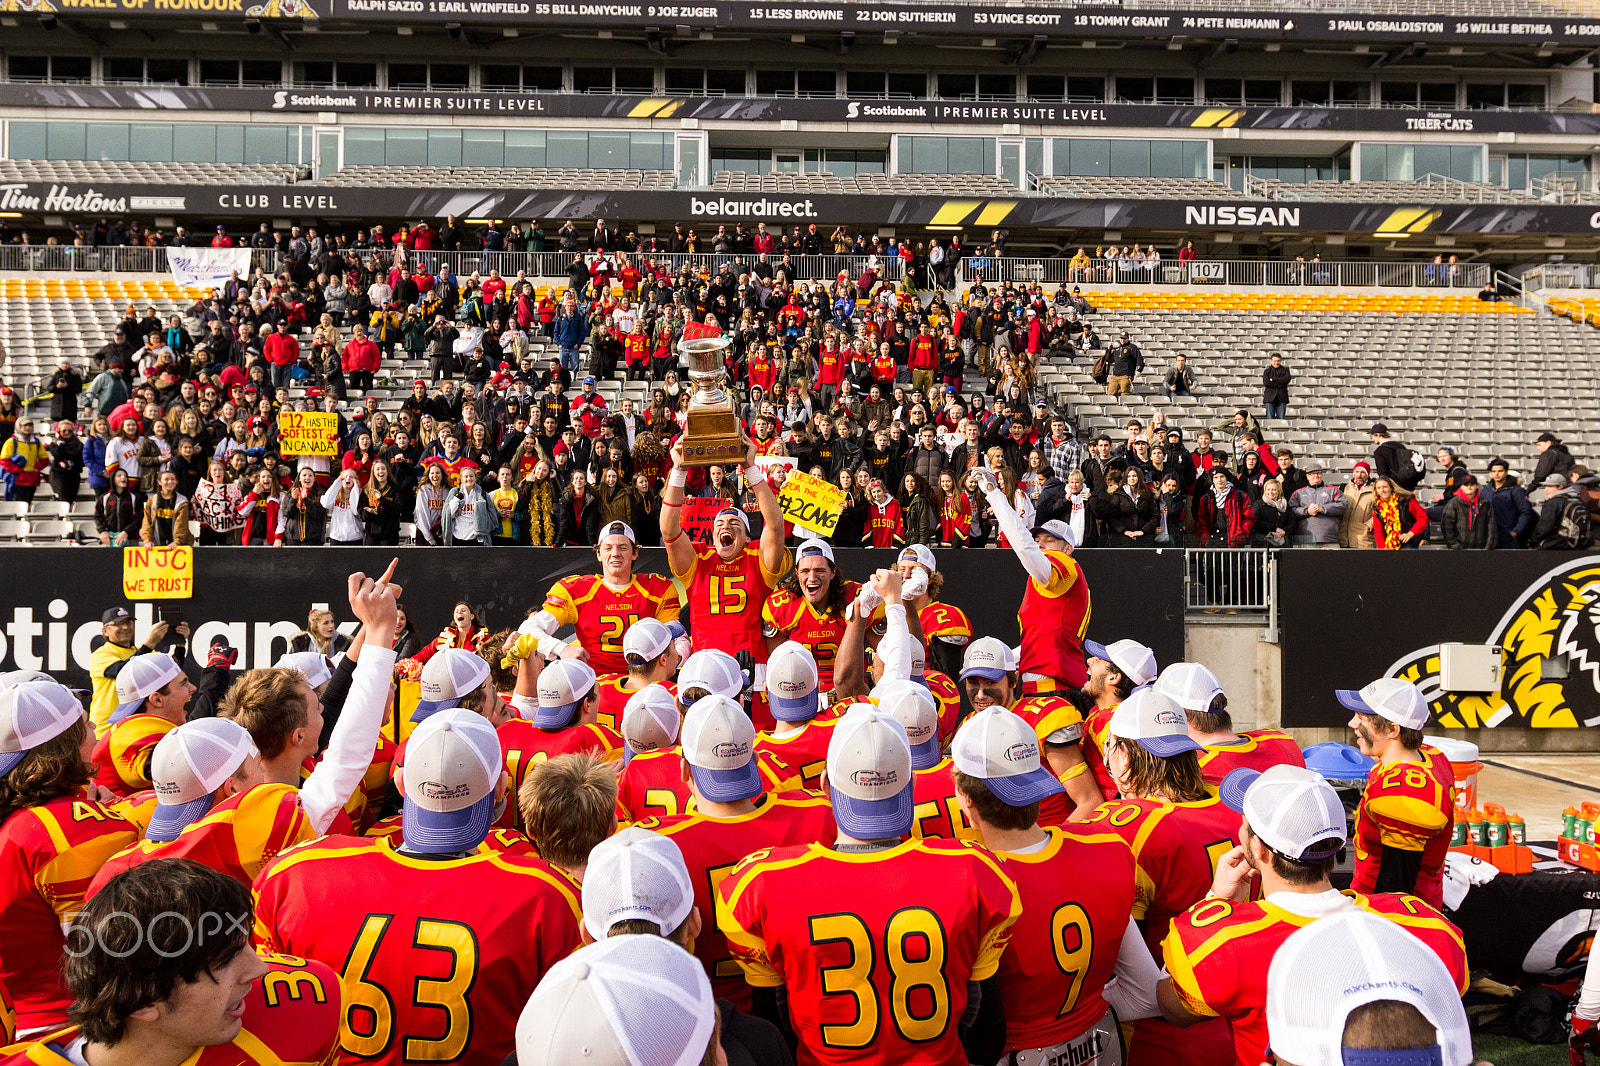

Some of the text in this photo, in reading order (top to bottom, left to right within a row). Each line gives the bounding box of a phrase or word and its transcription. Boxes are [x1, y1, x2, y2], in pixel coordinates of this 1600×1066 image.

[62, 0, 243, 12] WALL OF HONOUR
[347, 0, 424, 12] RALPH SAZIO
[429, 2, 530, 14] 1 EARL WINFIELD
[535, 3, 641, 16] 55 BILL DANYCHUK
[647, 6, 718, 18] 9 JOE ZUGER
[749, 8, 844, 21] 15 LESS BROWNE
[856, 10, 957, 23] 22 DON SUTHERIN
[973, 12, 1062, 25] 53 VINCE SCOTT
[1074, 15, 1171, 28] 18 TOMMY GRANT
[1182, 17, 1280, 30] 74 PETE NEUMANN
[1328, 19, 1444, 33] 3 PAUL OSBALDISTON
[1455, 22, 1553, 36] 16 WILLIE BETHEA
[1564, 24, 1578, 36] 14
[291, 94, 357, 107] Scotiabank
[374, 96, 545, 111] PREMIER SUITE LEVEL
[863, 105, 927, 117] Scotiabank
[943, 107, 1107, 121] PREMIER SUITE LEVEL
[1406, 118, 1474, 131] TIGER-CATS
[0, 184, 127, 213] Tim Hortons
[218, 194, 338, 210] CLUB LEVEL
[1186, 206, 1300, 227] NISSAN
[1195, 264, 1221, 277] 107
[632, 340, 644, 351] 26
[306, 418, 321, 428] HAS
[322, 417, 337, 428] THE
[282, 428, 325, 439] SOFTEST
[283, 440, 336, 452] IN CANADA
[784, 482, 801, 493] FOR
[804, 488, 818, 499] THE
[789, 470, 844, 498] TUESDAYS ARE
[206, 483, 230, 502] 21
[703, 498, 726, 507] OUT!
[963, 514, 972, 525] 12
[128, 549, 188, 570] IN JC
[716, 564, 740, 572] NELSON
[125, 577, 192, 592] WE TRUST
[709, 574, 748, 615] 15
[605, 603, 633, 611] NELSON
[933, 608, 952, 624] 2
[807, 629, 836, 638] NELSON
[1022, 695, 1057, 715] 12
[1381, 767, 1427, 790] 28
[426, 791, 470, 800] CHAMPIONS
[1083, 801, 1142, 827] 50
[1568, 844, 1580, 862] G
[1470, 856, 1482, 866] G
[608, 904, 652, 915] marchants.com
[1049, 900, 1095, 1018] 9
[807, 905, 951, 1050] 38
[339, 912, 480, 1065] 63
[1342, 980, 1423, 997] marchants.com
